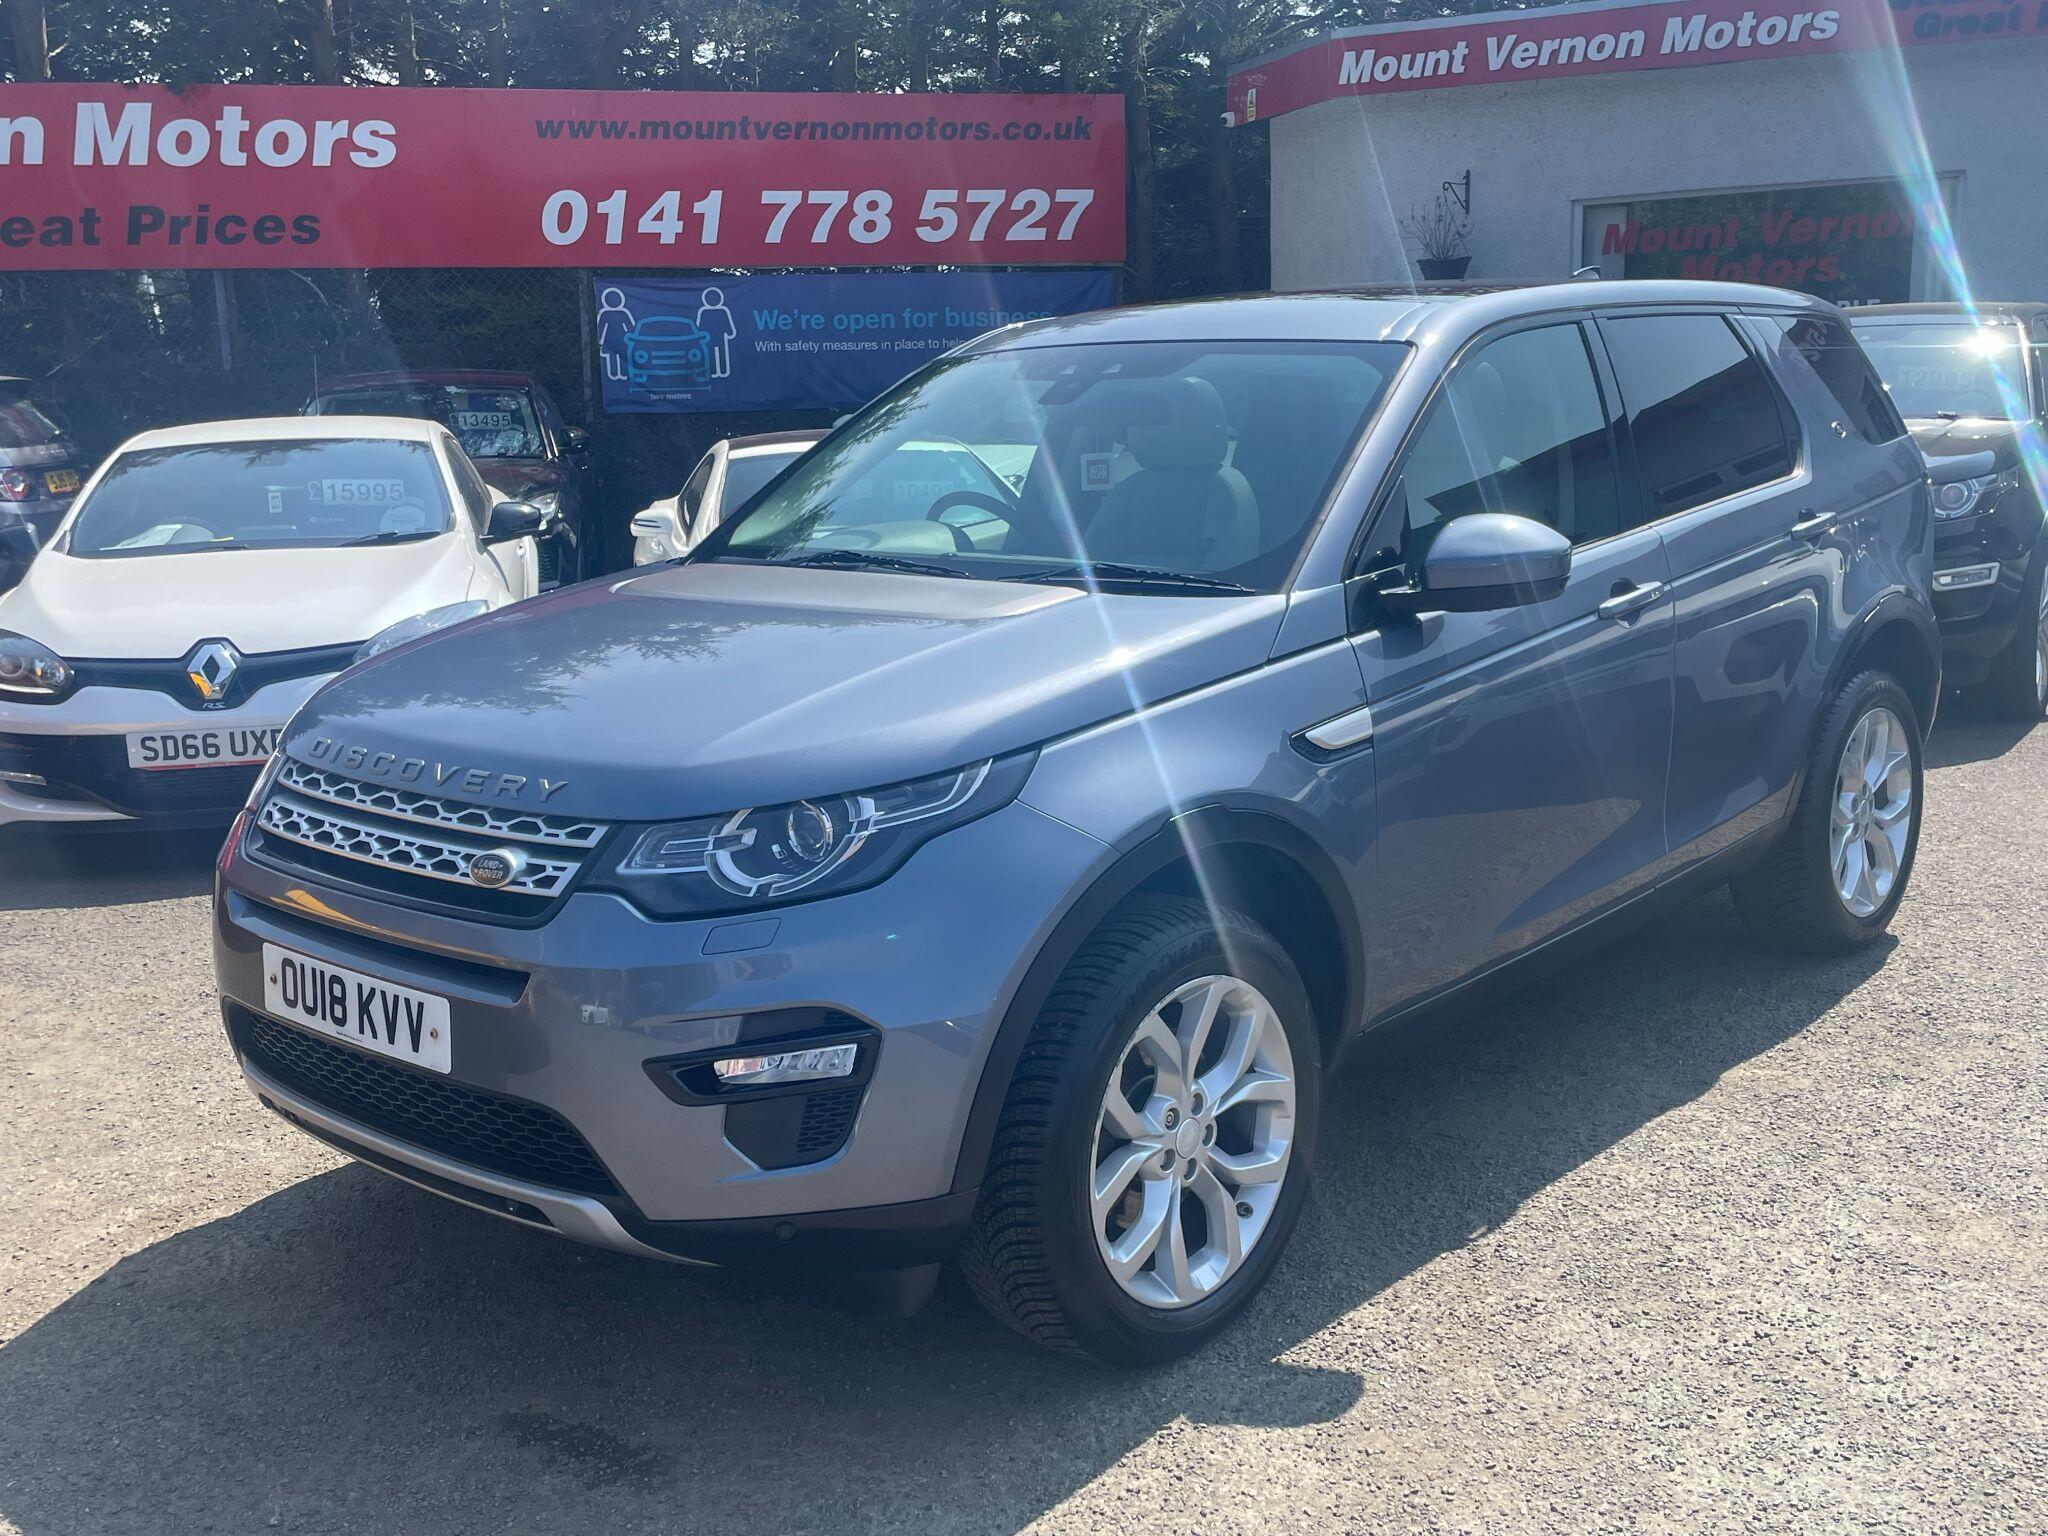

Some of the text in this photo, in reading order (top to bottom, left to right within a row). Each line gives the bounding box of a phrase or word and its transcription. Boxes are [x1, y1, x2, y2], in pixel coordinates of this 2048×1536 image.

[1338, 10, 1840, 85] Mount Vernon Motors
[73, 102, 397, 168] Motors
[535, 115, 1092, 141] www.mountvernonmotors.co.uk
[0, 204, 321, 247] eat Prices
[541, 189, 1095, 245] 0141 778 5727
[1603, 214, 1743, 256] Mount
[1680, 253, 1841, 284] Motors
[753, 308, 826, 330] We’re
[833, 310, 896, 334] open
[902, 307, 938, 328] for
[755, 340, 782, 352] With
[784, 340, 820, 353] safety
[822, 340, 878, 351] measures
[881, 339, 892, 350] in
[894, 338, 926, 352] place
[928, 338, 940, 349] to
[140, 732, 221, 762] SD66
[308, 736, 569, 803] DISCOVERY
[477, 859, 499, 870] LAND
[477, 868, 504, 880] ROVER
[281, 957, 425, 1054] OU18 KVV
